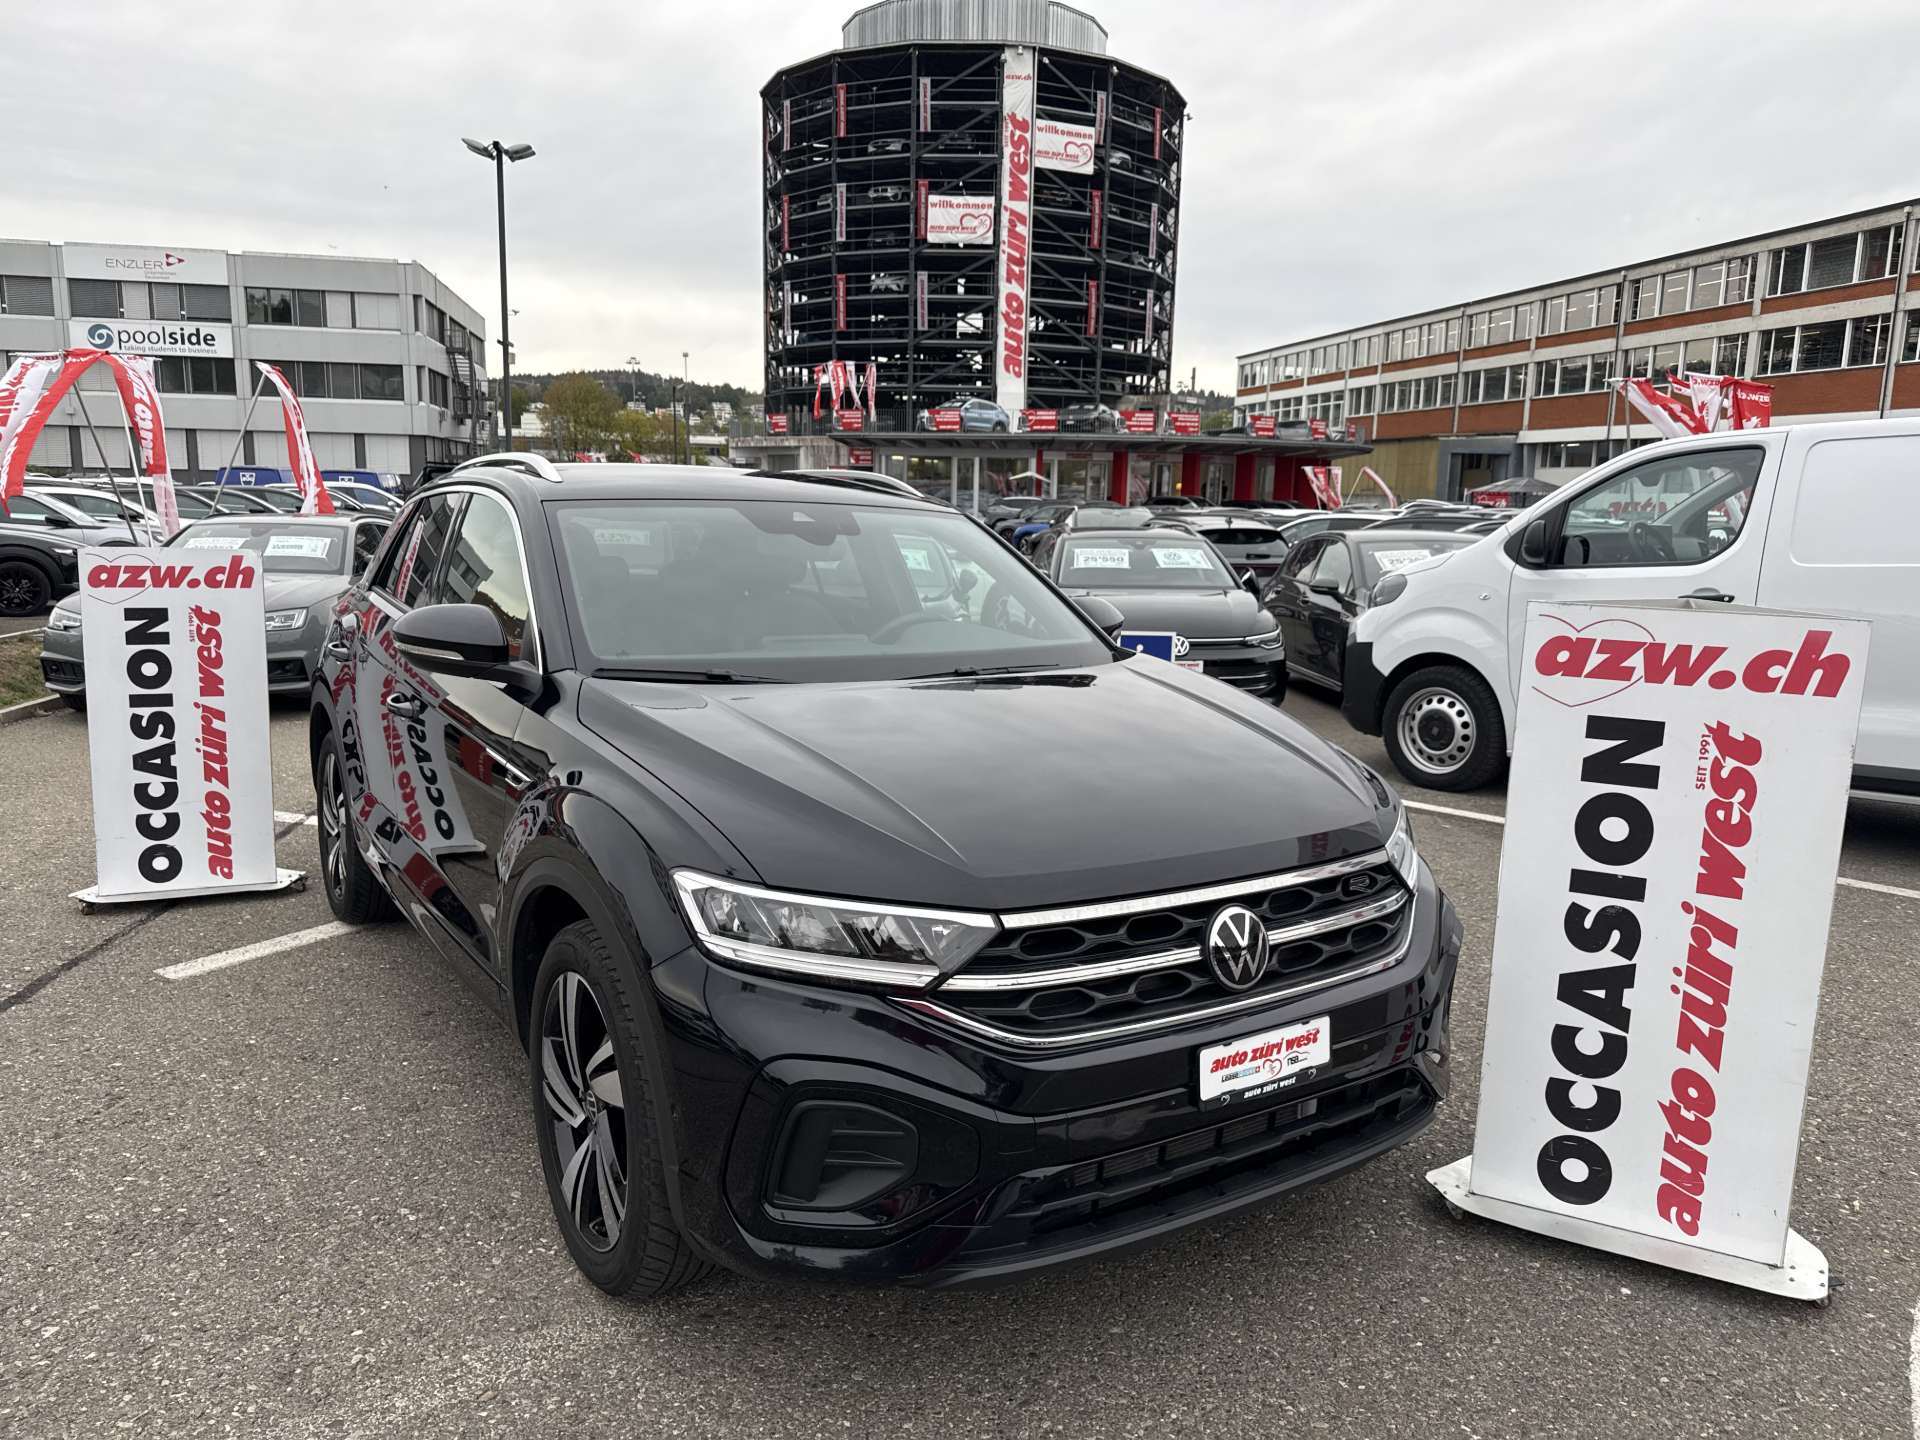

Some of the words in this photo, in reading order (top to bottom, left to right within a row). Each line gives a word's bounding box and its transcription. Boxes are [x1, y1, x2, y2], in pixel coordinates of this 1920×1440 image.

[1007, 112, 1030, 201] west
[1037, 125, 1093, 140] willkommen
[929, 199, 993, 209] willkommen
[105, 258, 164, 270] ENZLER
[1002, 205, 1027, 291] züri
[117, 326, 216, 350] poolside
[124, 345, 146, 353] taking
[148, 345, 177, 353] students
[188, 346, 217, 354] business
[1001, 292, 1025, 378] auto
[87, 555, 255, 589] azw.ch
[190, 604, 225, 697] west
[1535, 630, 1852, 698] azw.ch
[124, 607, 183, 883] OCCASION
[193, 702, 230, 788] züri
[1695, 766, 1707, 790] SEIT
[1698, 734, 1712, 760] 1991
[199, 790, 234, 880] auto
[1696, 720, 1762, 900] west
[1537, 714, 1666, 1205] OCCASION
[1670, 901, 1739, 1073] züri
[1210, 1049, 1248, 1073] auto
[1250, 1038, 1285, 1061] züri
[1285, 1026, 1320, 1049] west
[1244, 1087, 1261, 1099] auto
[1262, 1081, 1279, 1094] züri
[1279, 1076, 1297, 1088] west
[1656, 1067, 1717, 1237] auto
